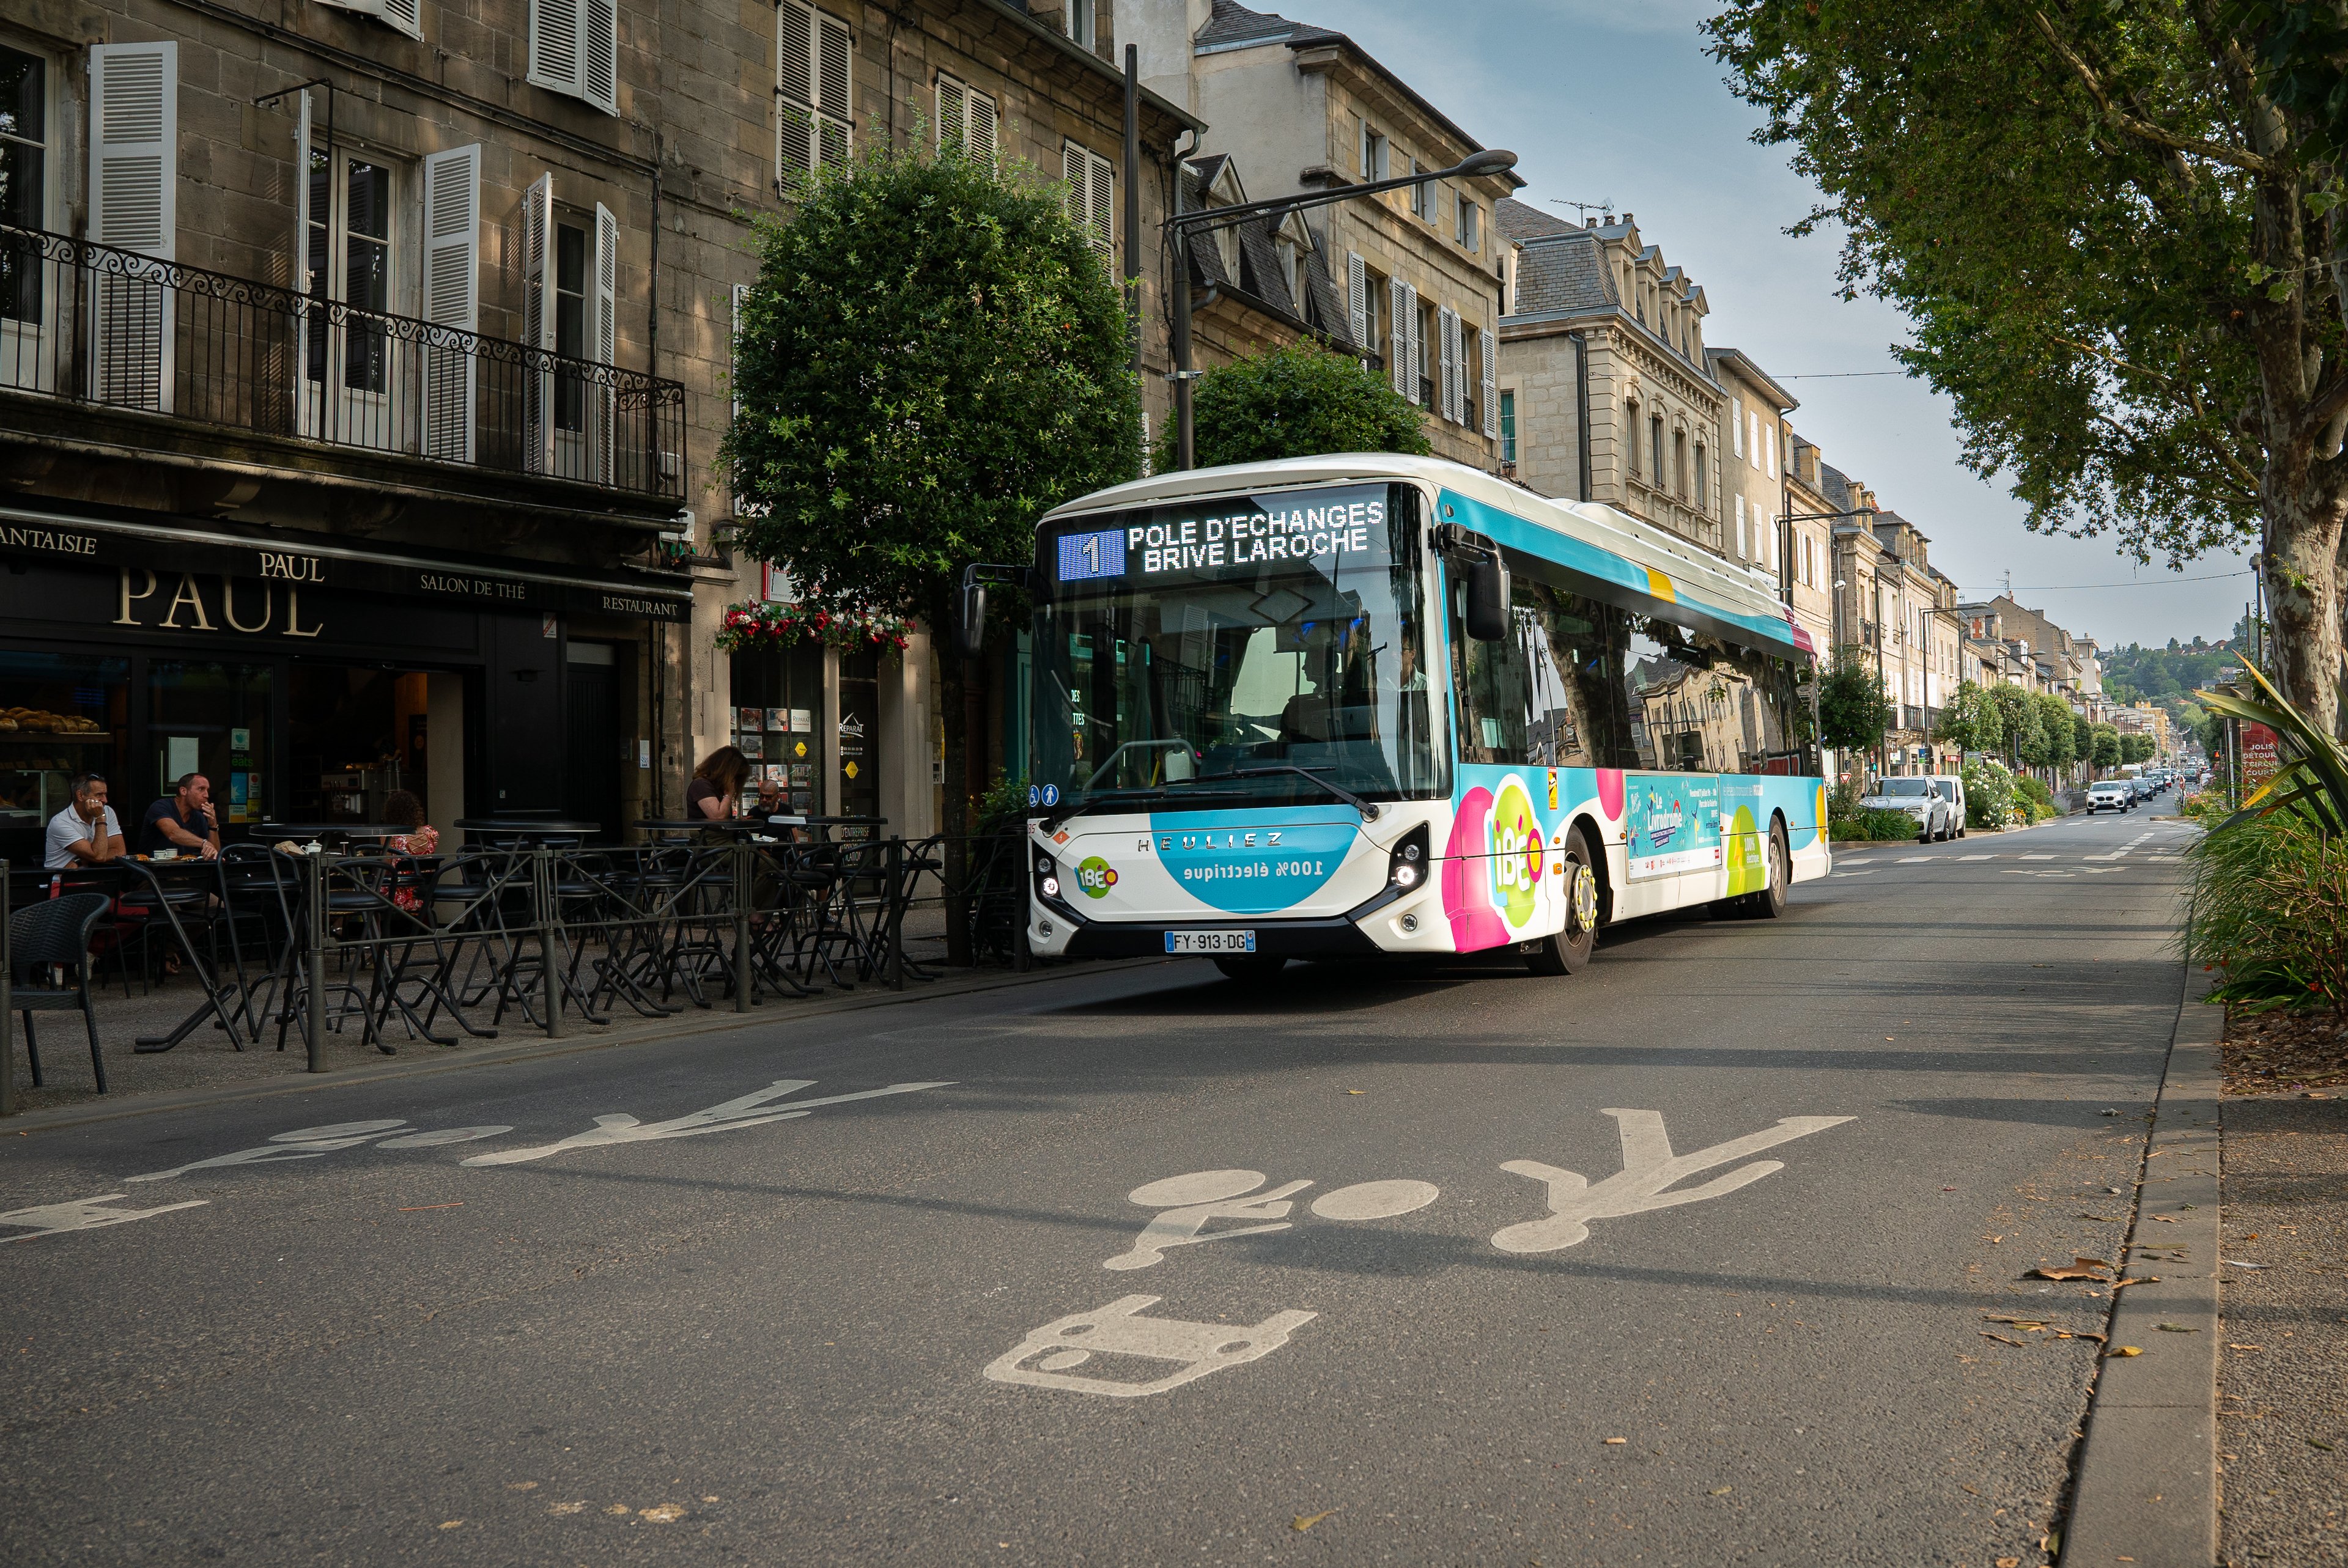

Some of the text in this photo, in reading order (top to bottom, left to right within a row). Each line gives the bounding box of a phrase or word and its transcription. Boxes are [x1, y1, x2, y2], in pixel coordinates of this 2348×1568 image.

[1129, 501, 1384, 550] POLE D'ECHANGES
[1082, 534, 1099, 573] 1
[1144, 528, 1368, 572] BRIVE LAROCHE
[259, 553, 325, 583] PAUL
[421, 575, 525, 600] SALON DE THÉ
[113, 567, 323, 637] PAUL
[602, 597, 677, 616] RESTAURANT
[839, 723, 863, 732] REPARAT
[232, 757, 254, 768] eats
[1656, 792, 1663, 809] Le
[1647, 808, 1683, 831] Livrodrome
[1138, 832, 1283, 852] HEULIEZ
[1174, 934, 1246, 949] FY-913-DG
